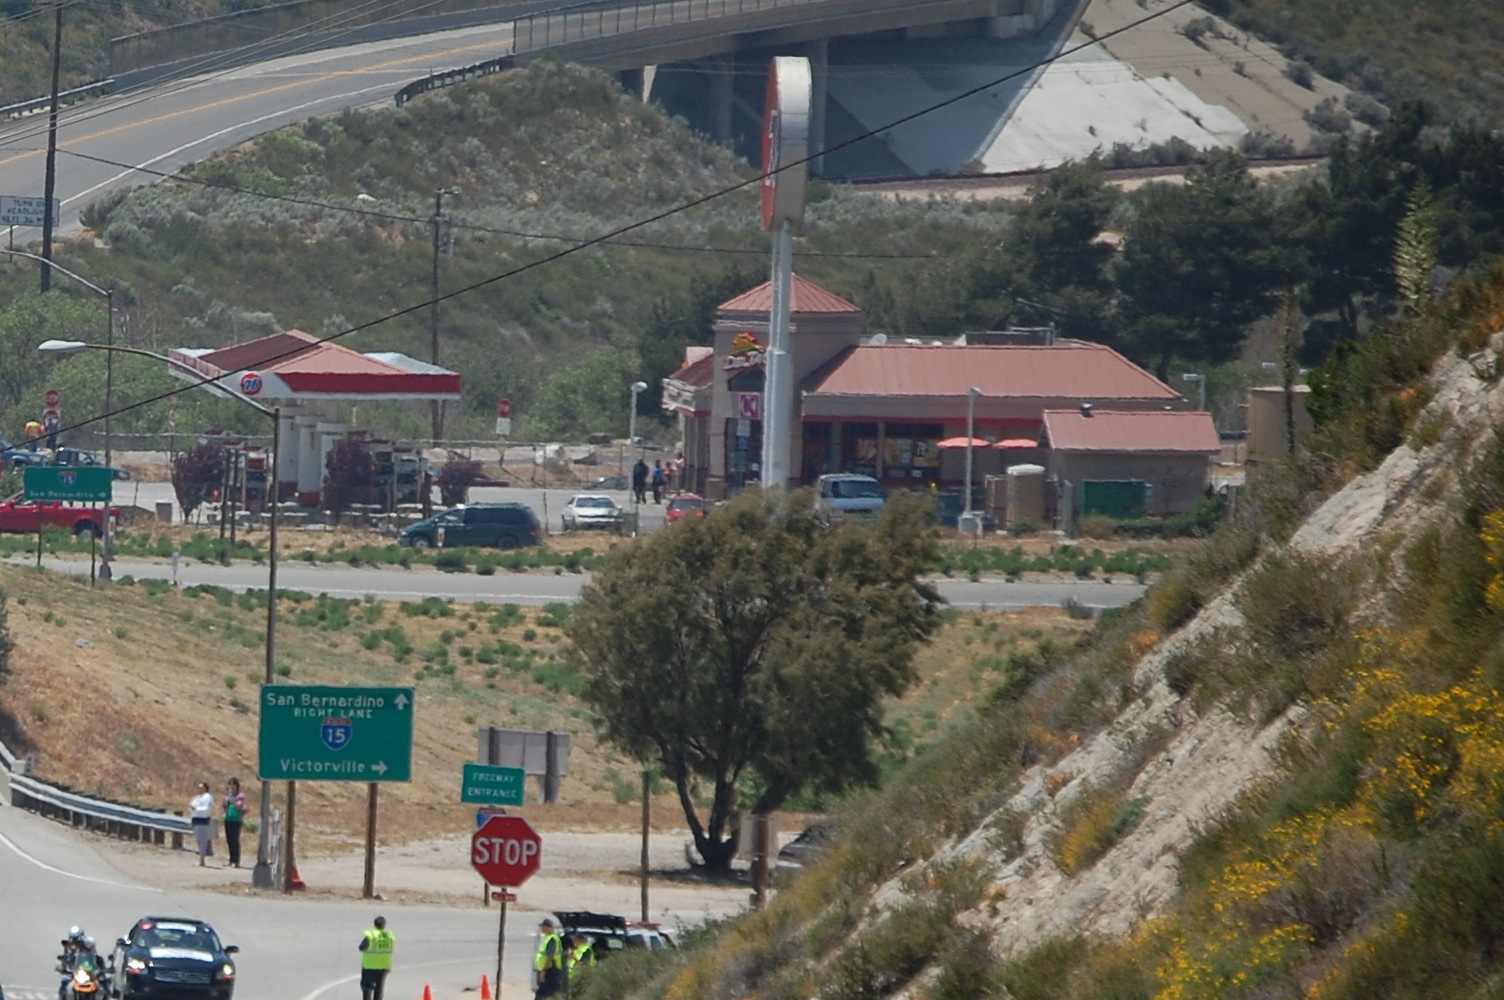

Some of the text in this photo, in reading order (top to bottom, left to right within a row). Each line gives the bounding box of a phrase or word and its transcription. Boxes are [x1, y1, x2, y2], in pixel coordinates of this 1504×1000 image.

[266, 693, 385, 708] San Bernardino
[294, 707, 373, 719] RIGHT LANE
[328, 728, 346, 744] 15
[280, 758, 366, 773] Victorville
[472, 771, 515, 783] FREEWAY
[468, 787, 517, 799] ENTRANCE
[475, 837, 538, 867] STOP
